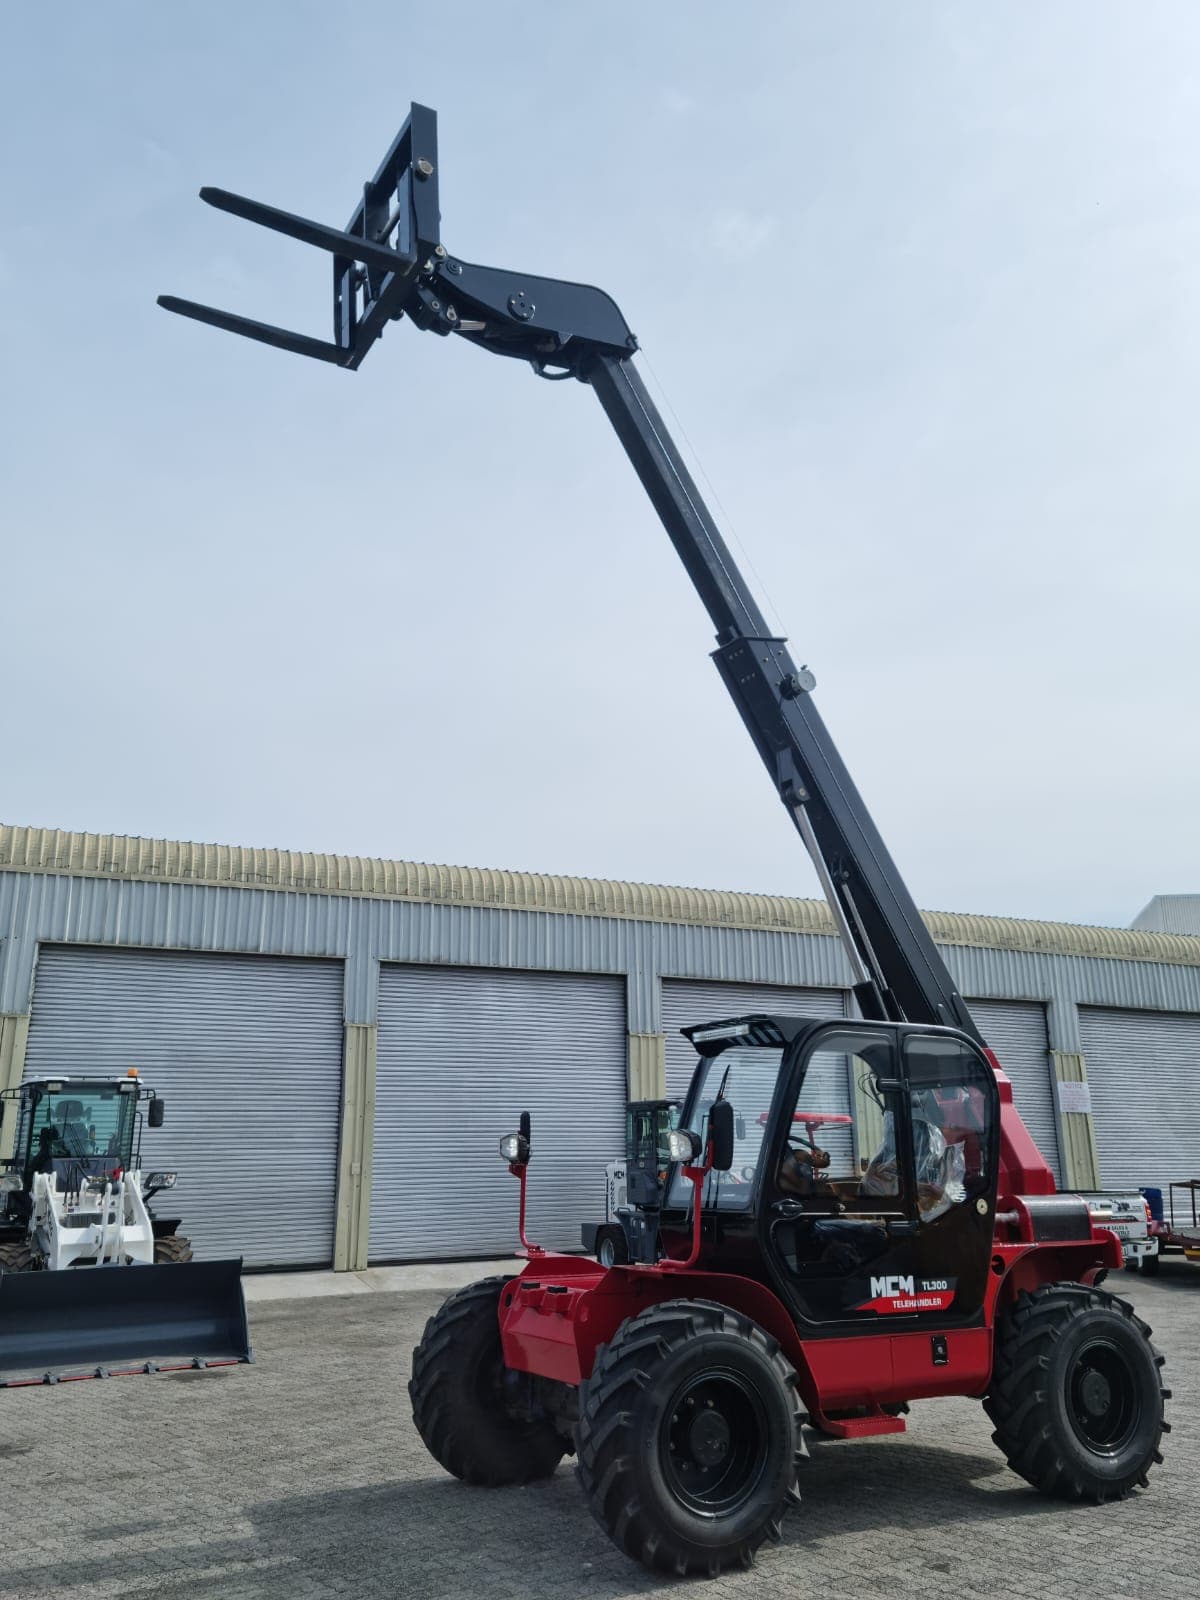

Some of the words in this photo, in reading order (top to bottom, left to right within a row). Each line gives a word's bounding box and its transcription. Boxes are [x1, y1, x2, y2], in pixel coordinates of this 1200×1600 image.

[870, 1275, 915, 1298] MCM
[921, 1280, 948, 1291] TL300
[892, 1297, 942, 1309] TELEHANDLER
